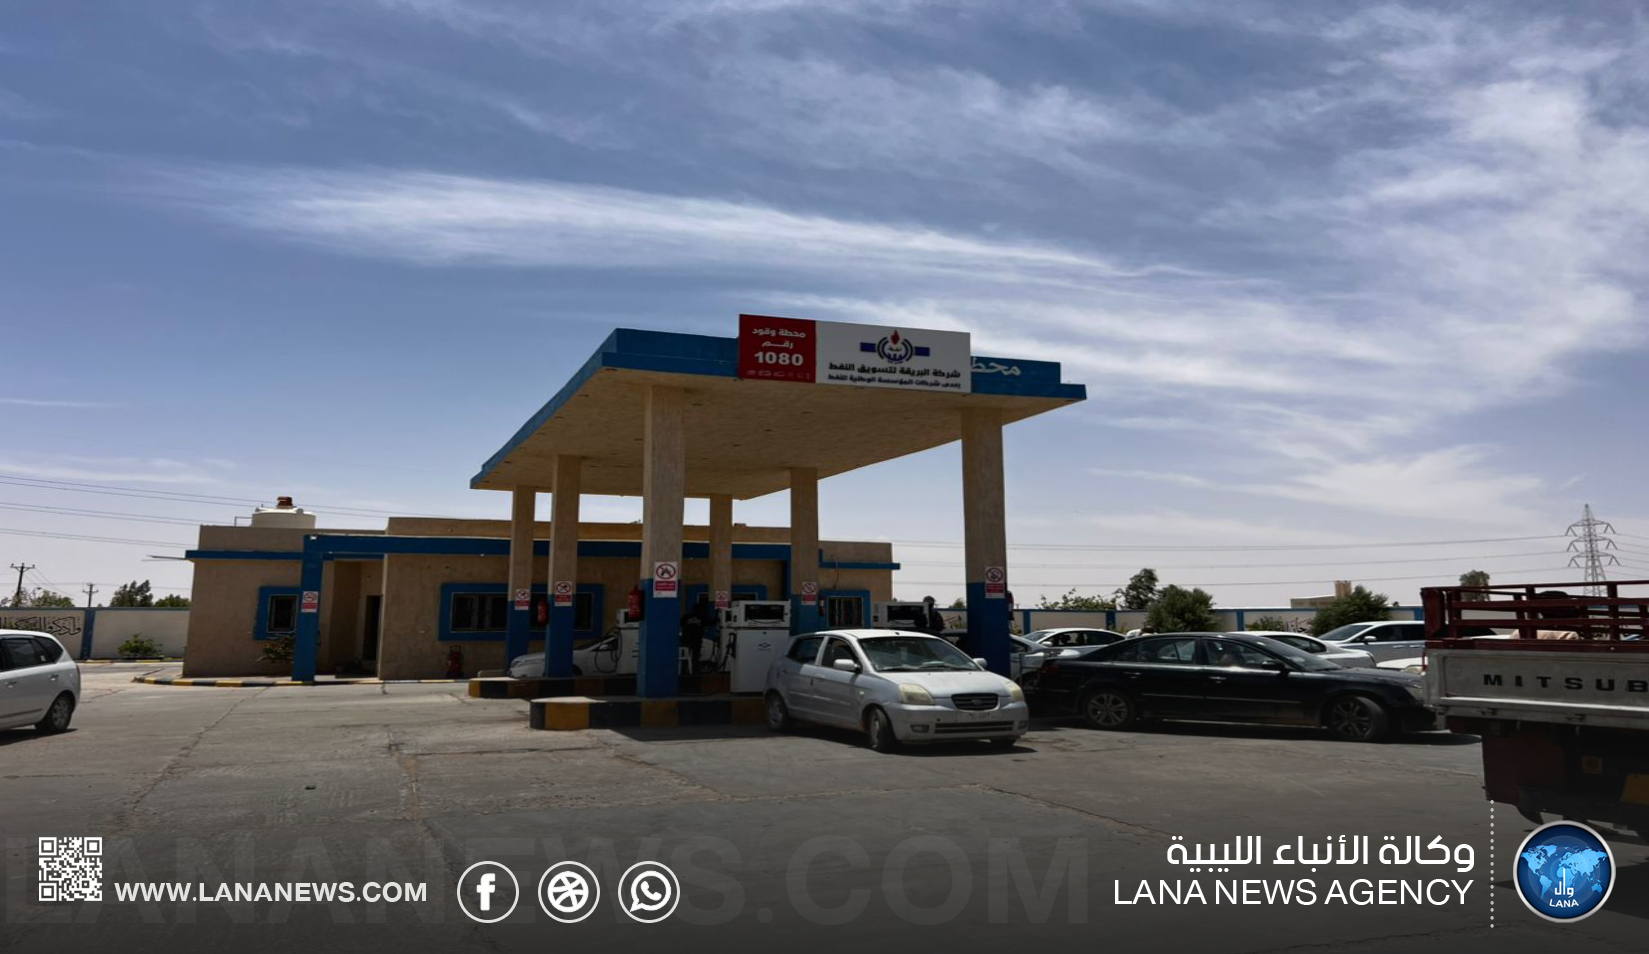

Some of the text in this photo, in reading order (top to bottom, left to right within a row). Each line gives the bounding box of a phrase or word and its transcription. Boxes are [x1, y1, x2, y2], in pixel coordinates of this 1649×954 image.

[752, 327, 806, 338] محطة وقود
[754, 351, 804, 366] 1080
[828, 362, 961, 379] شركة البريقة لتسويق النفط
[969, 357, 1021, 376] محط
[849, 374, 877, 384] الوطنية
[877, 376, 914, 385] المؤسسة
[915, 378, 940, 388] شركات
